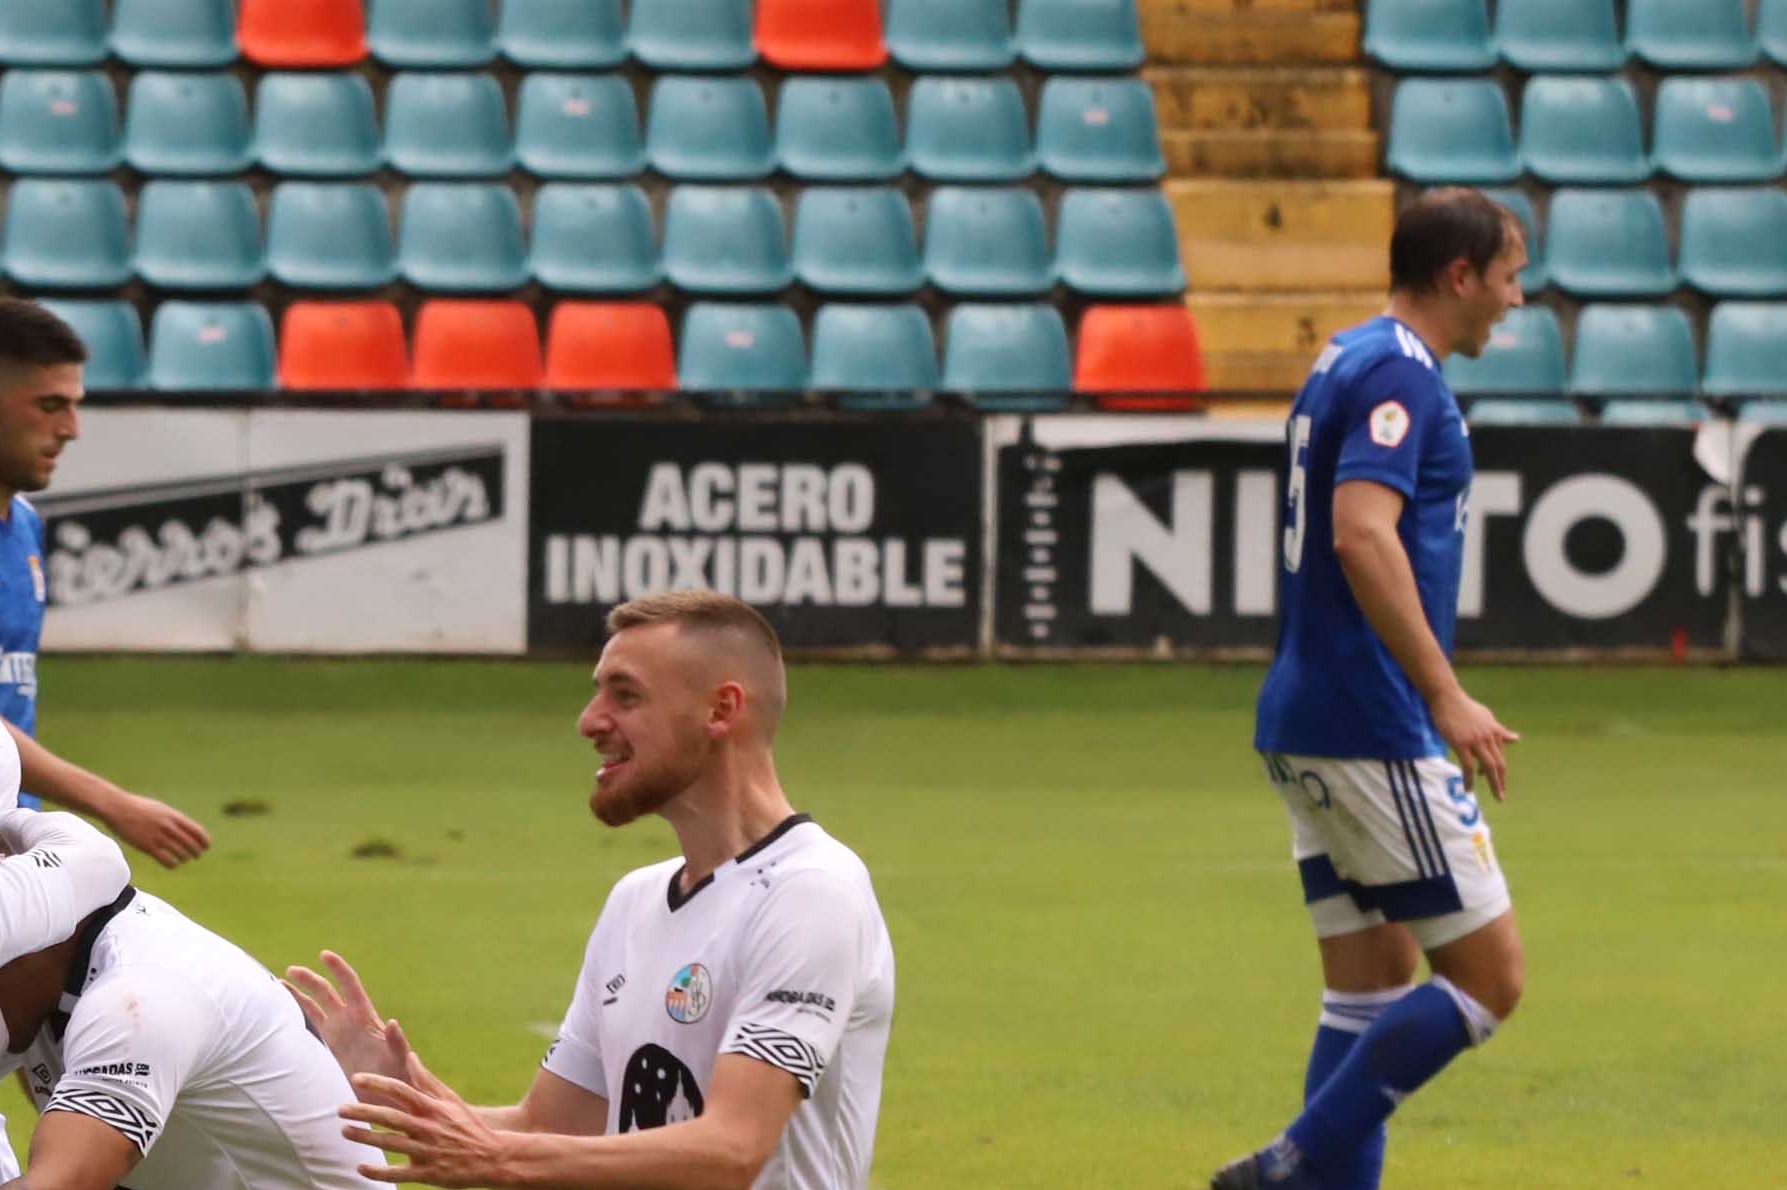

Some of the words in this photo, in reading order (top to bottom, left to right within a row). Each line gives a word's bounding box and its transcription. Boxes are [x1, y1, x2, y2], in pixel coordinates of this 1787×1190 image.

[639, 461, 876, 532] ACERO
[544, 534, 967, 607] INOXIDABLE
[1088, 469, 1667, 620] NITO
